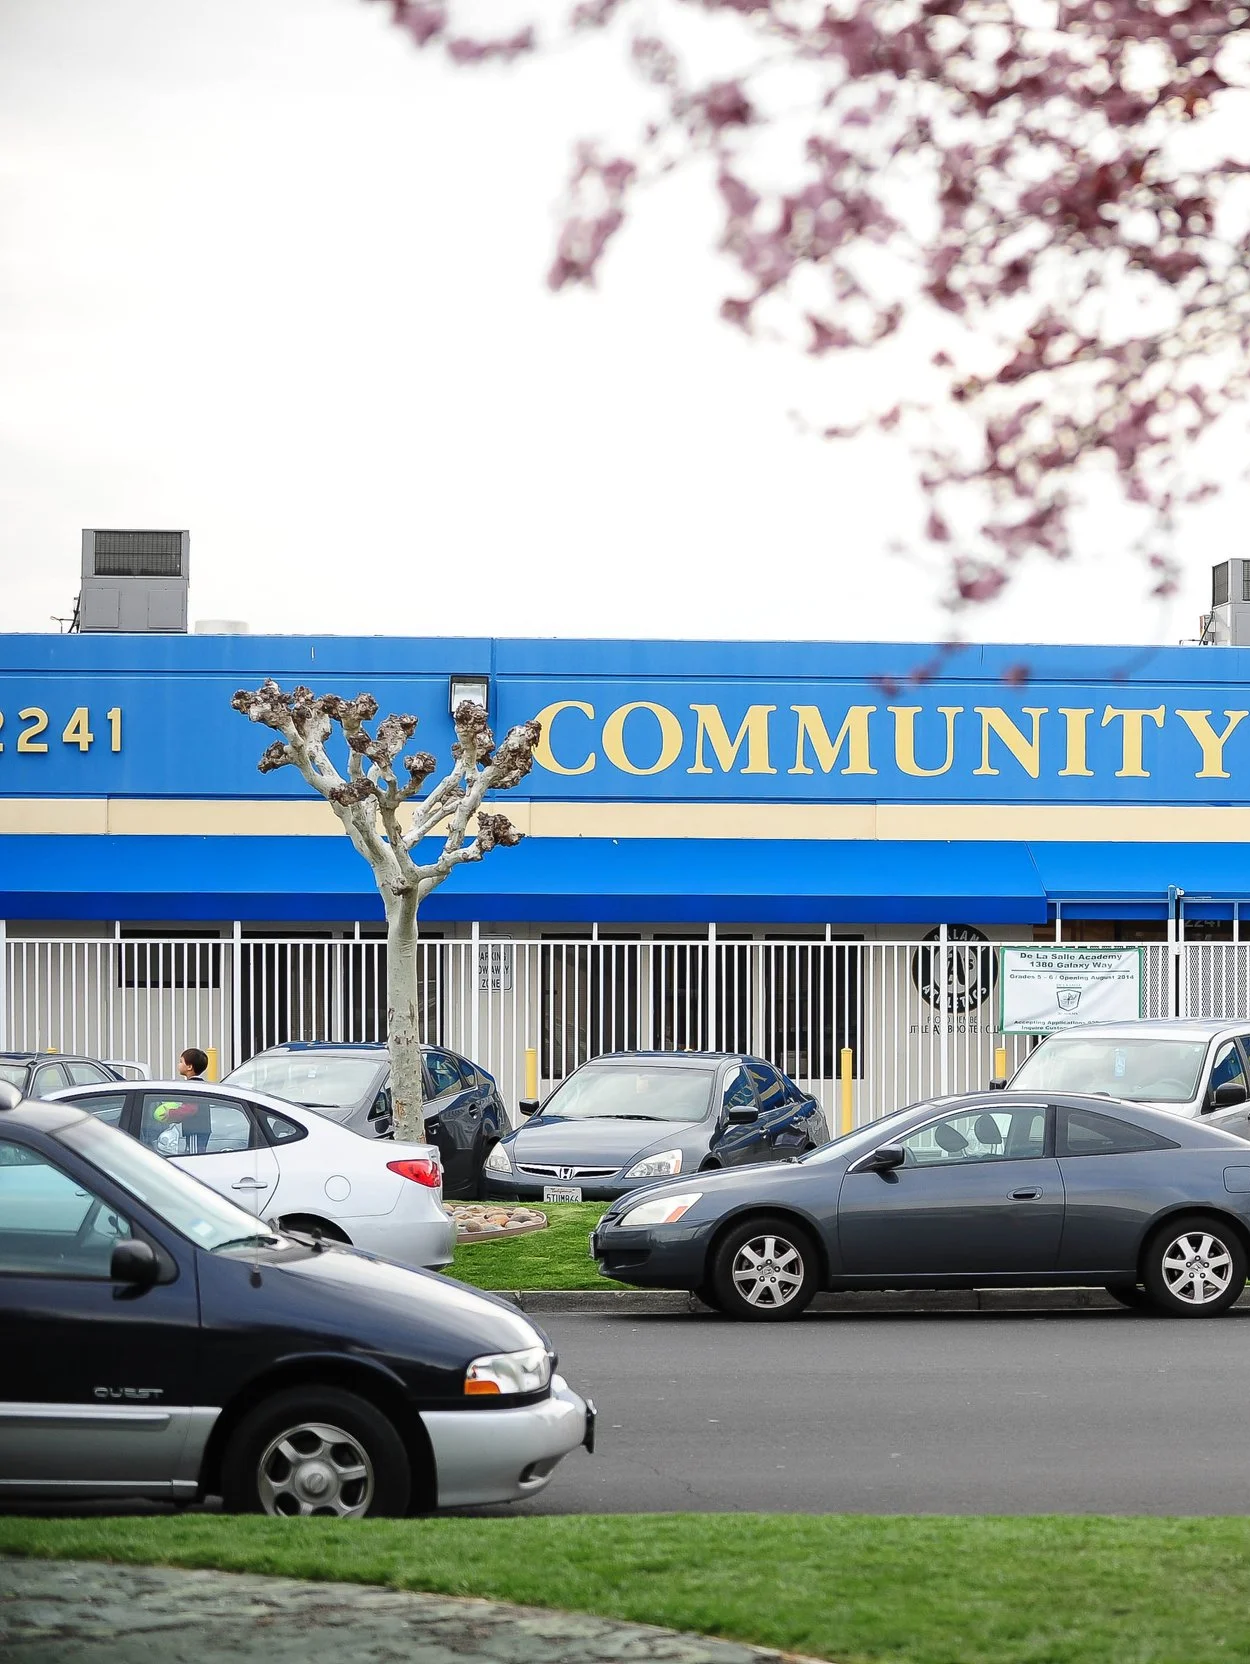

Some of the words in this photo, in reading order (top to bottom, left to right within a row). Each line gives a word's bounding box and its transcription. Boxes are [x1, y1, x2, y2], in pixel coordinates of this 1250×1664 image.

[0, 707, 122, 752] 241
[530, 700, 1248, 778] COMMUNITY
[1056, 962, 1090, 970] Galaxy
[1092, 961, 1113, 969] Way
[1078, 953, 1122, 961] Academy
